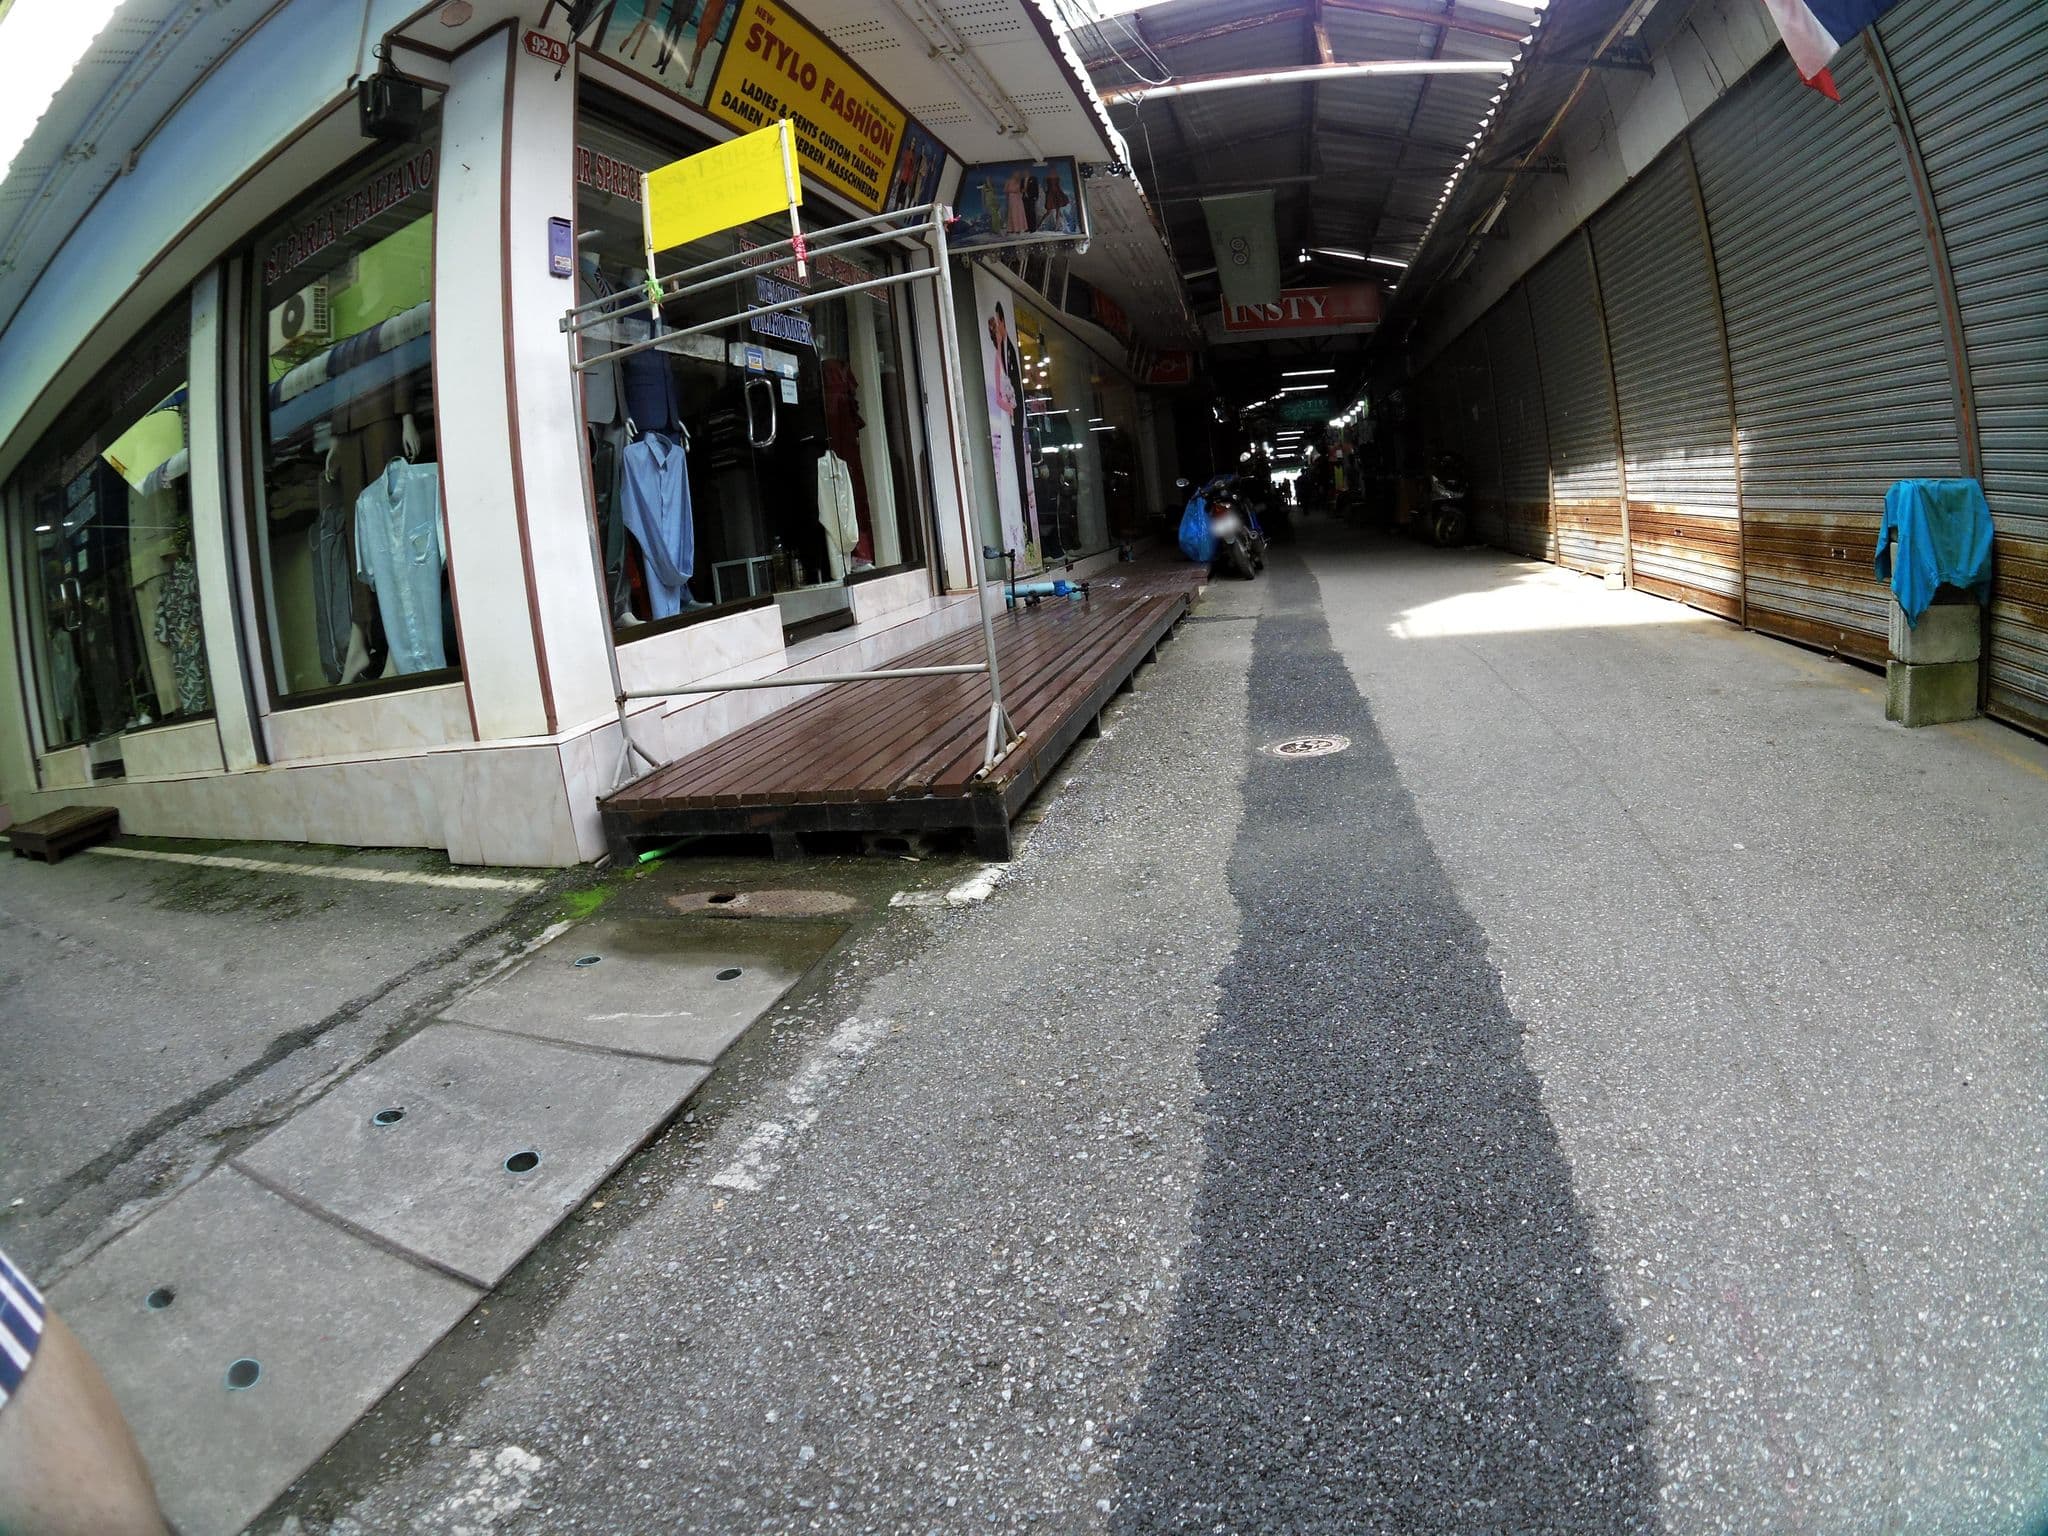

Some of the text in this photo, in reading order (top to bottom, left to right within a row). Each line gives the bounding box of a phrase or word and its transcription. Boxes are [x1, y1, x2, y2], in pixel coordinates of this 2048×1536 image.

[531, 35, 562, 61] 92/9
[754, 5, 776, 26] NEW
[740, 78, 878, 183] LADIES & GENTS CUSTOM TAILORS
[745, 23, 818, 91] STYLO
[820, 77, 894, 156] FASHION
[720, 90, 763, 127] DAMEN
[826, 157, 880, 203] MASSCHNEIDER
[858, 143, 886, 169] GALLERY
[285, 205, 336, 273] PARLA
[343, 148, 433, 235] ITALIANO
